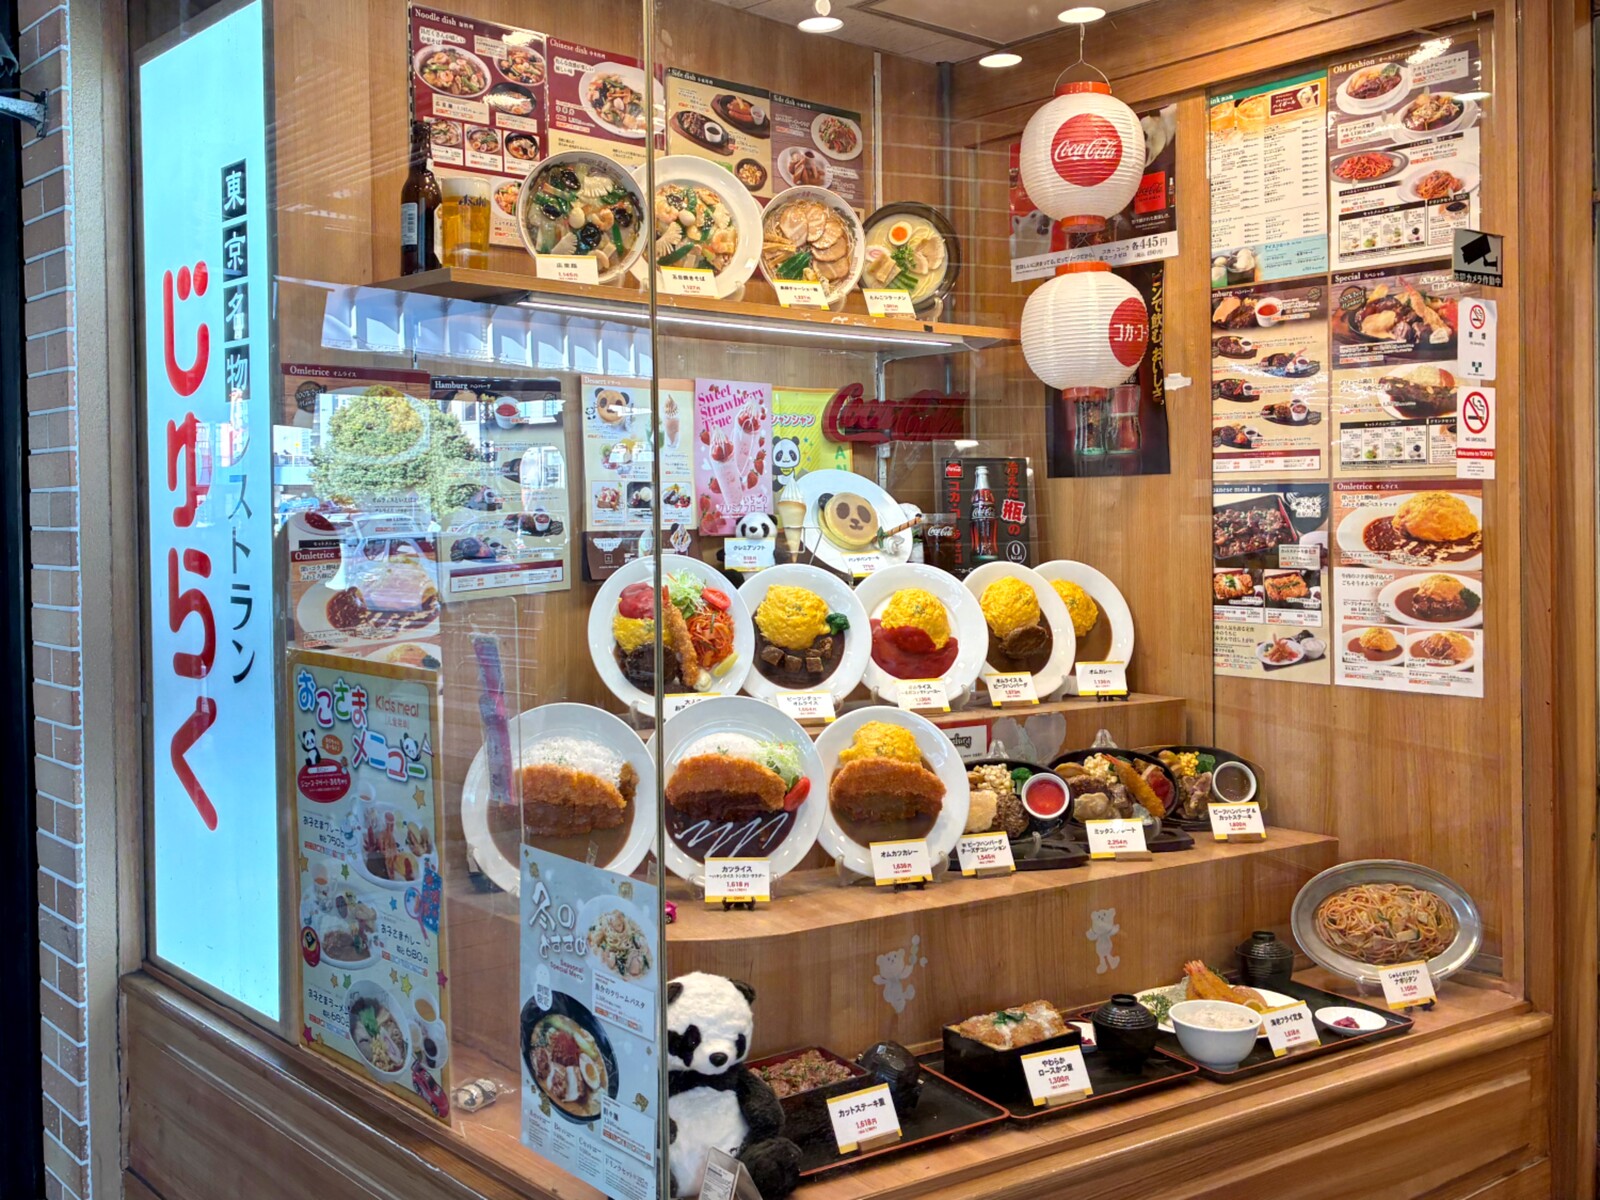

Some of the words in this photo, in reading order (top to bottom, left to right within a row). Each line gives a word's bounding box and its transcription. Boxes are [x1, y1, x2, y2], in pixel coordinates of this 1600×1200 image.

[414, 9, 441, 22] Noodle
[441, 17, 457, 26] dish
[549, 39, 574, 51] Chinese
[574, 46, 588, 55] dish
[1333, 65, 1347, 74] Old
[1348, 58, 1376, 71] fashion
[671, 69, 684, 79] Side
[684, 72, 696, 81] dish
[774, 94, 785, 104] Side
[784, 97, 796, 106] dish
[1054, 138, 1118, 163] Coca-Cola
[458, 194, 487, 207] Asahi
[1132, 236, 1168, 250] 各445円
[223, 169, 248, 393] 東京名物
[1335, 272, 1361, 284] Special
[289, 365, 331, 377] Omletrice
[434, 380, 468, 390] Hamburg
[584, 376, 608, 386] Dessert
[697, 384, 732, 406] Sweet
[702, 414, 732, 432] Time
[1233, 485, 1250, 493] meal
[1337, 482, 1373, 491] Omletrice
[927, 525, 954, 538] Coca-Cola
[163, 260, 218, 831] じゅらく
[295, 551, 335, 561] Omletrice
[993, 682, 1028, 690] ビーフハンバーグ
[298, 671, 367, 728] おこさま
[375, 695, 397, 712] Kids
[397, 704, 420, 718] meal
[352, 730, 427, 782] メニュー
[1213, 807, 1252, 815] ビーフハンバーグ
[1218, 813, 1252, 821] カットステーキ
[303, 816, 346, 836] お子さまプレート
[880, 848, 919, 858] オムカツカレー
[960, 844, 1007, 854] チーズデコレーション
[722, 865, 753, 873] カツライス
[528, 881, 576, 931] 冬の
[381, 924, 422, 946] お子さまカレー
[1393, 975, 1418, 986] ナポリタン
[1270, 1012, 1304, 1027] 海老フライ定食
[1041, 1056, 1066, 1068] やわらか
[1038, 1063, 1074, 1077] ロースかつ重
[1048, 1075, 1071, 1085] 1,300円
[838, 1097, 887, 1118] カットステーキ重
[855, 1117, 878, 1130] 1,618円
